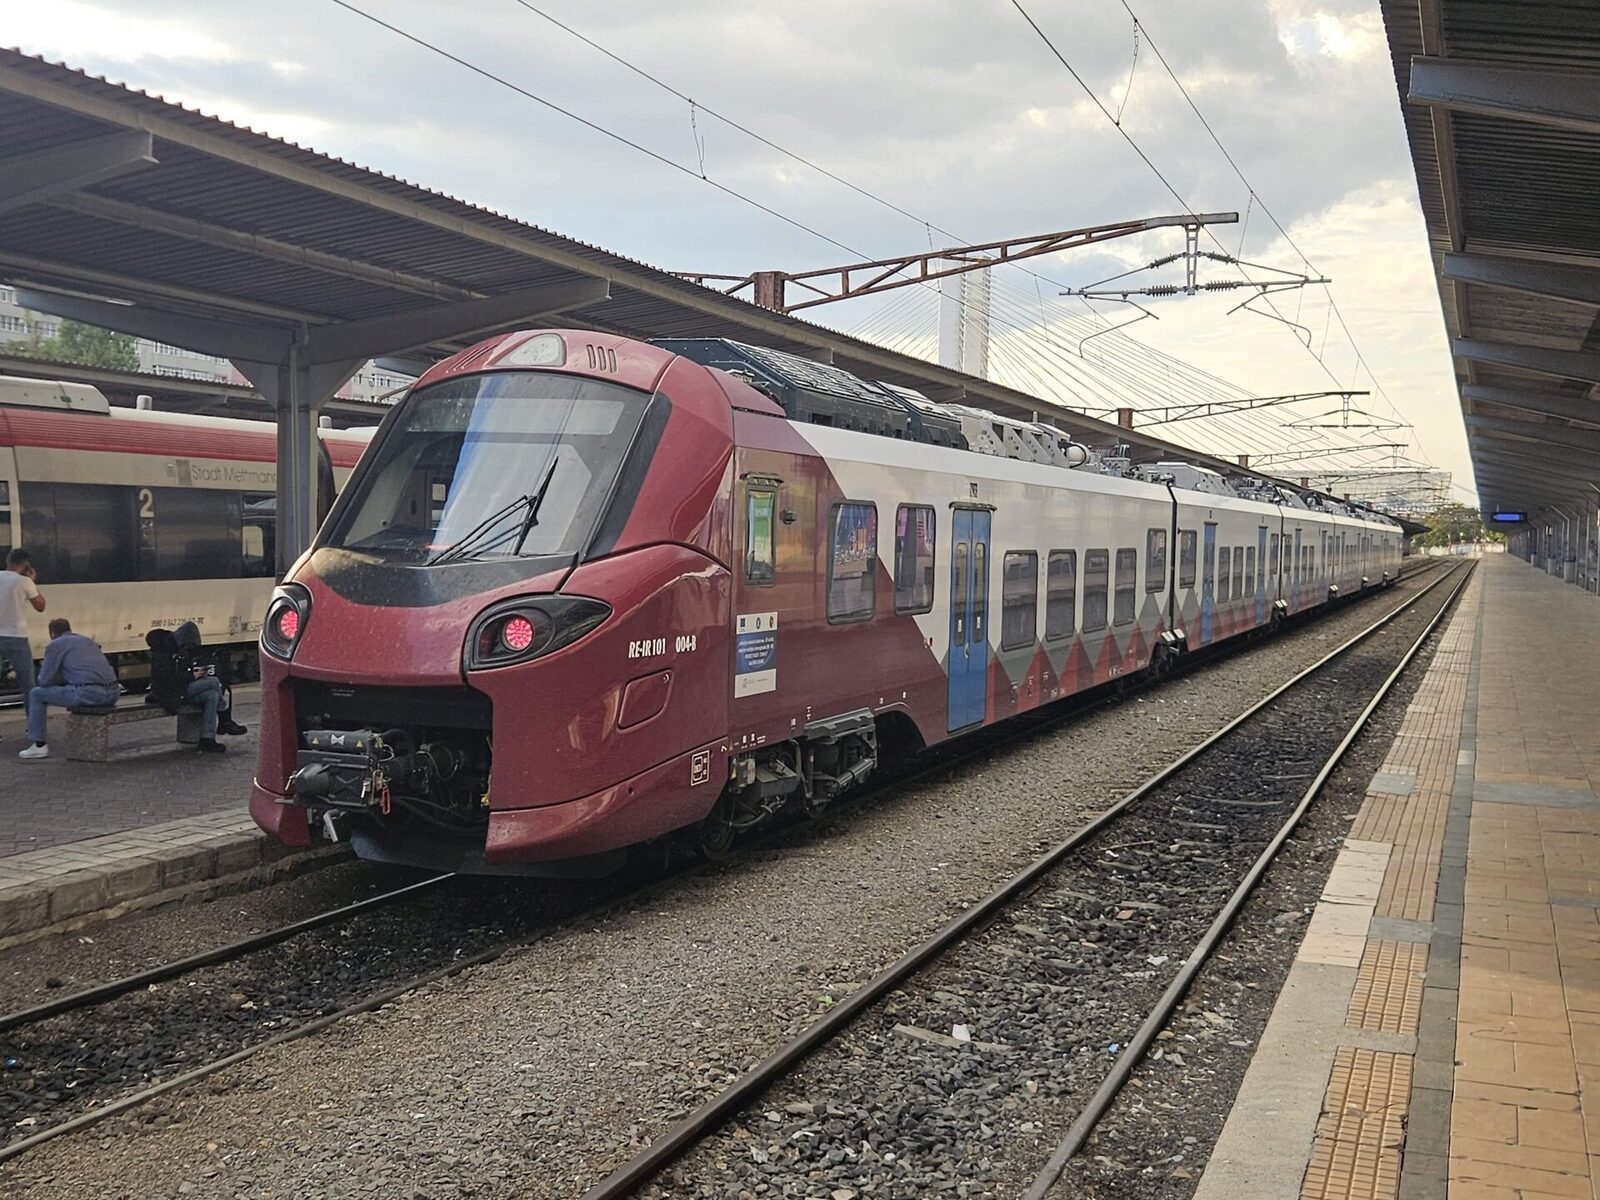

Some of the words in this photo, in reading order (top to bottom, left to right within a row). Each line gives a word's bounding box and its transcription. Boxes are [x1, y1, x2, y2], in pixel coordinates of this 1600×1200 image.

[191, 464, 221, 481] Stadt
[223, 466, 276, 484] Mettman
[139, 488, 155, 518] 2
